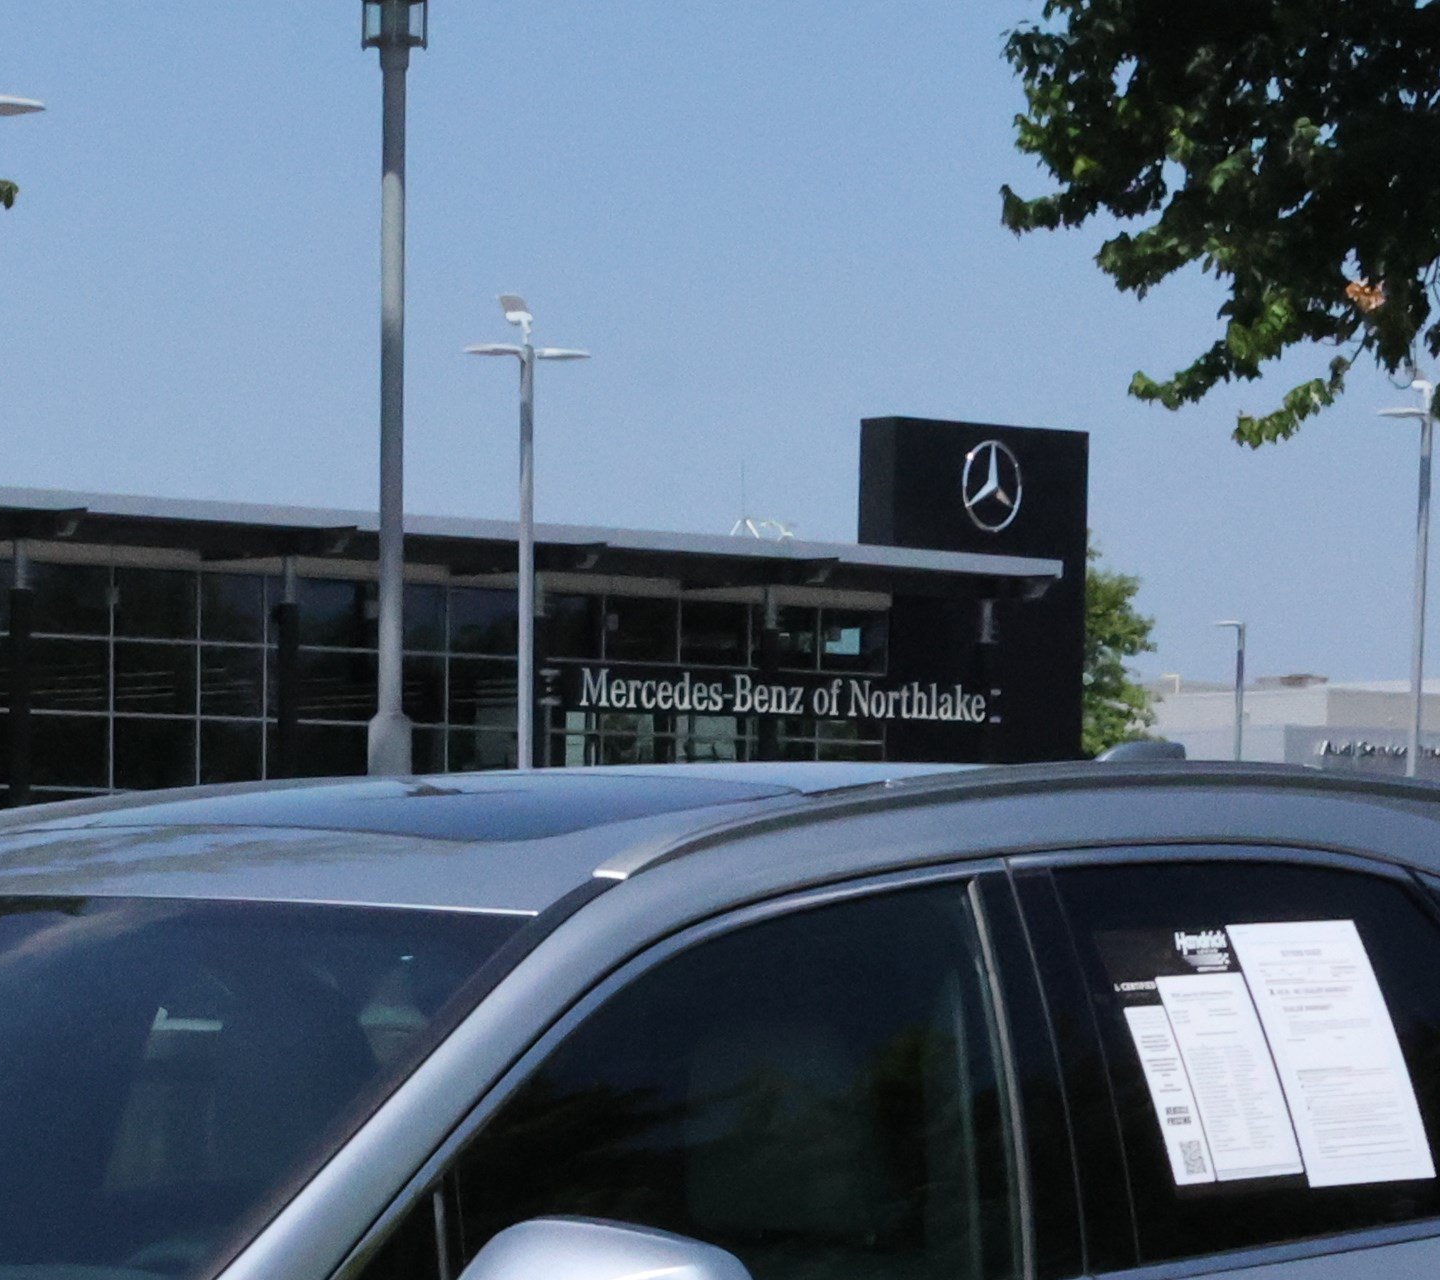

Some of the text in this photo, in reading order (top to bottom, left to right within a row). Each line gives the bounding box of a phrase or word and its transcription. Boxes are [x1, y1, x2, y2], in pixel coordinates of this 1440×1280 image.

[579, 667, 987, 723] Mercedes-Benz of Northlake
